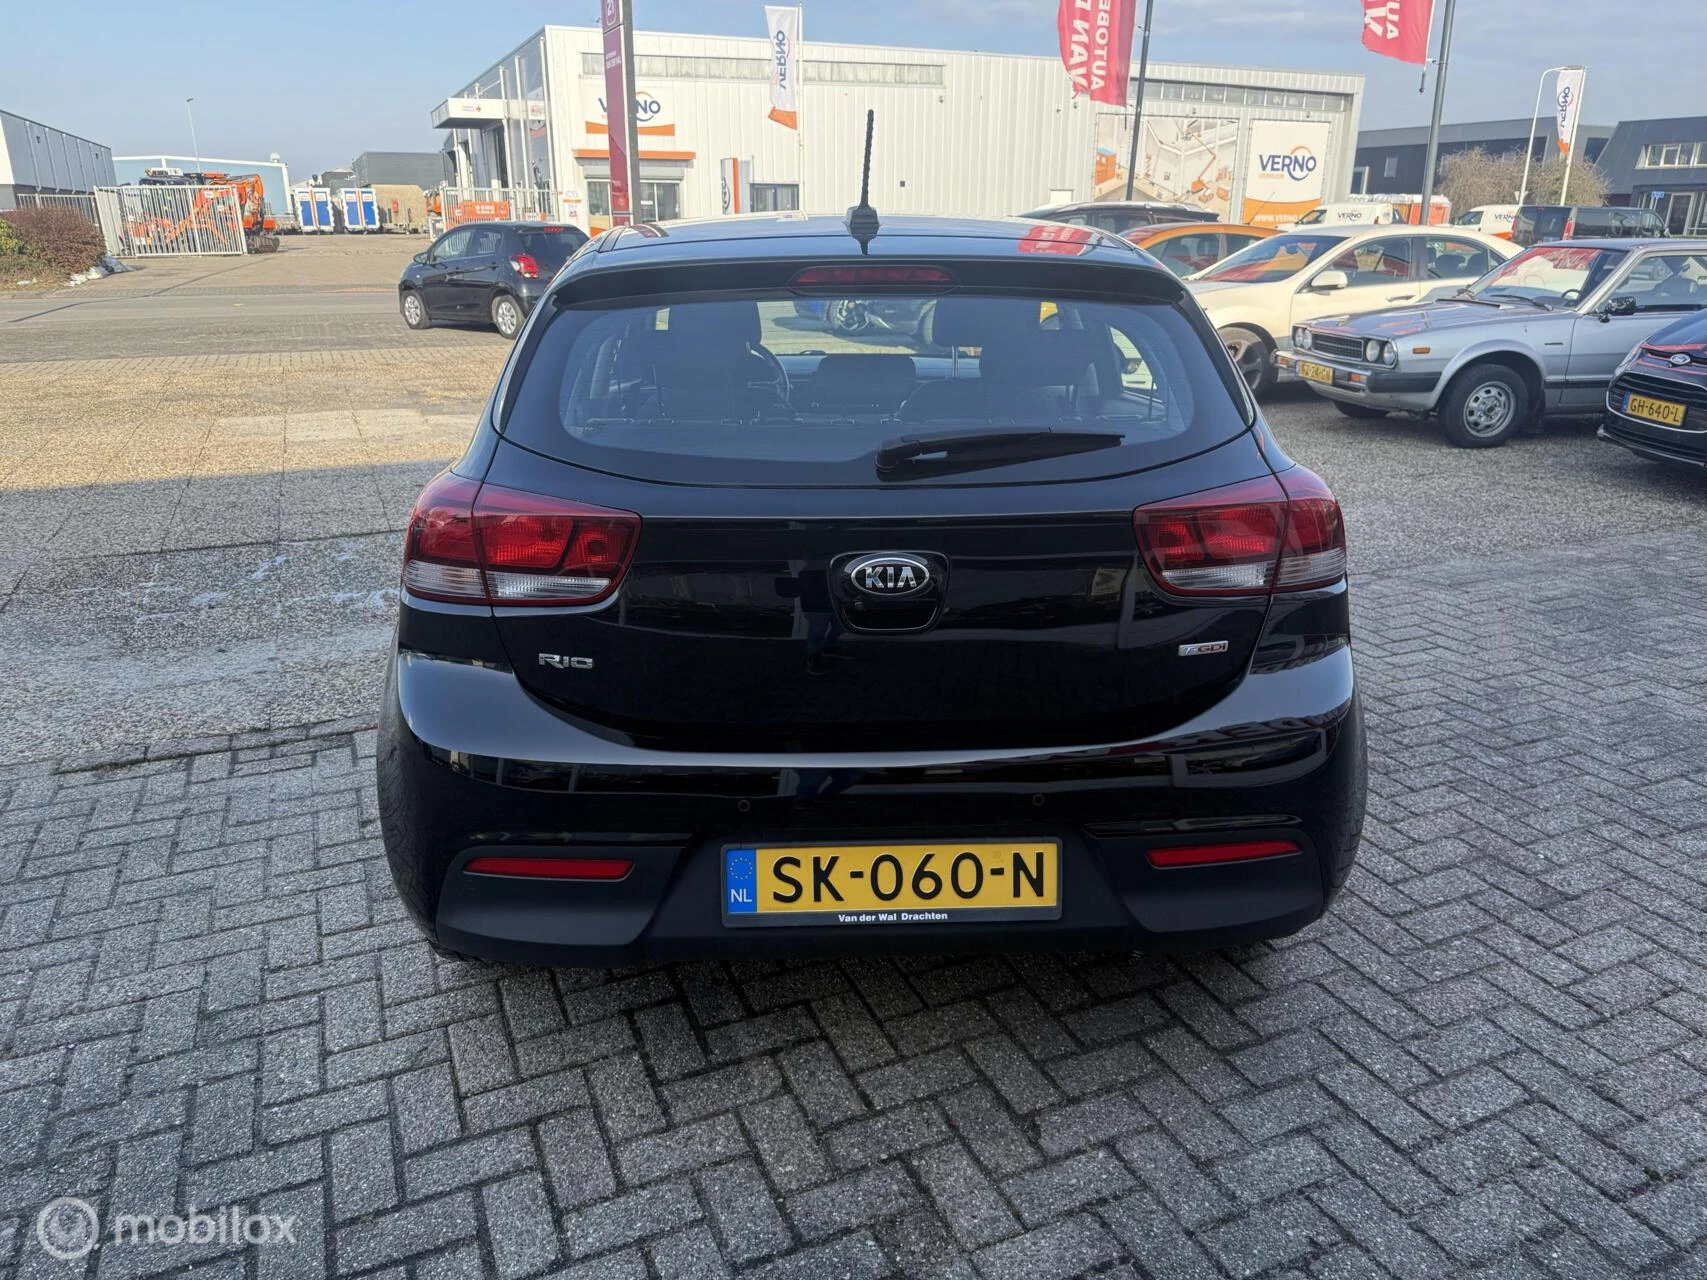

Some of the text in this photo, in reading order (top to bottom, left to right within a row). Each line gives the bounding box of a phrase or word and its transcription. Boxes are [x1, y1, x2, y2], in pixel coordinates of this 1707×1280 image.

[1258, 154, 1317, 180] VERNO
[1337, 212, 1362, 220] VERNO
[1630, 398, 1680, 423] GH-640-L
[864, 566, 917, 589] KIA
[772, 851, 1045, 903] SK-060-N
[730, 888, 752, 903] NL
[838, 912, 949, 923] Van der Wal Drachten
